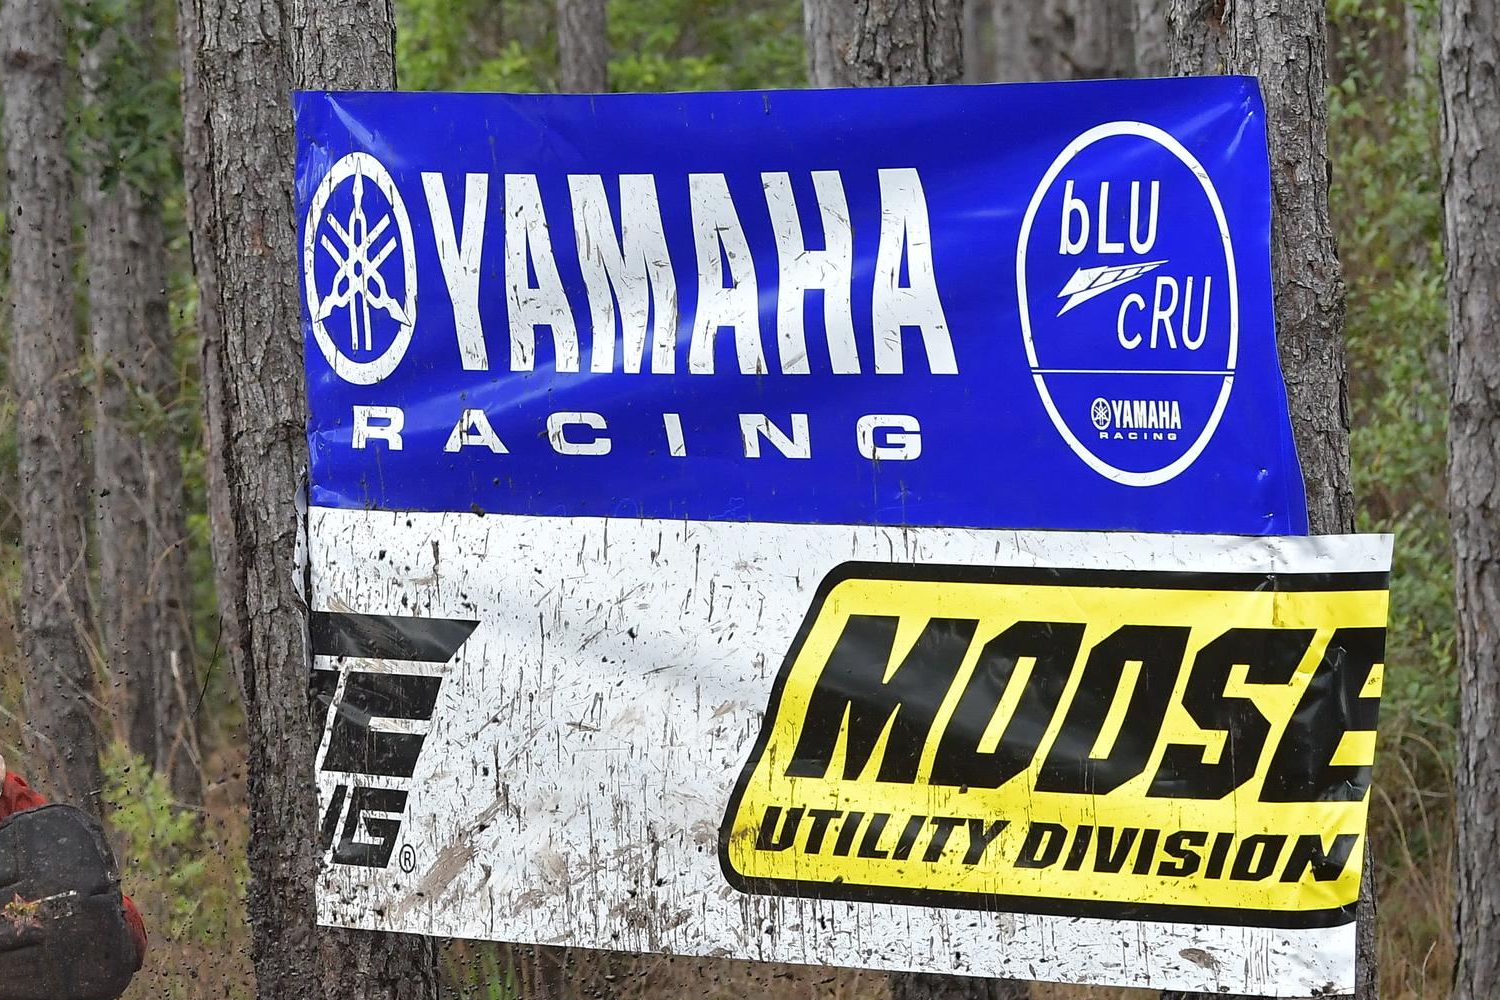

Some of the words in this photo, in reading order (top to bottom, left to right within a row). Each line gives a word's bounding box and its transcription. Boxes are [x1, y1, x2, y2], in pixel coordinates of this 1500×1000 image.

[420, 167, 960, 376] YAMAHA
[351, 404, 923, 461] RACING
[1099, 431, 1178, 441] RACING
[1111, 399, 1183, 430] YAMAHA
[785, 614, 1388, 803] MOOSE
[755, 805, 1011, 866] UTILITY
[1014, 820, 1360, 883] DIVISION
